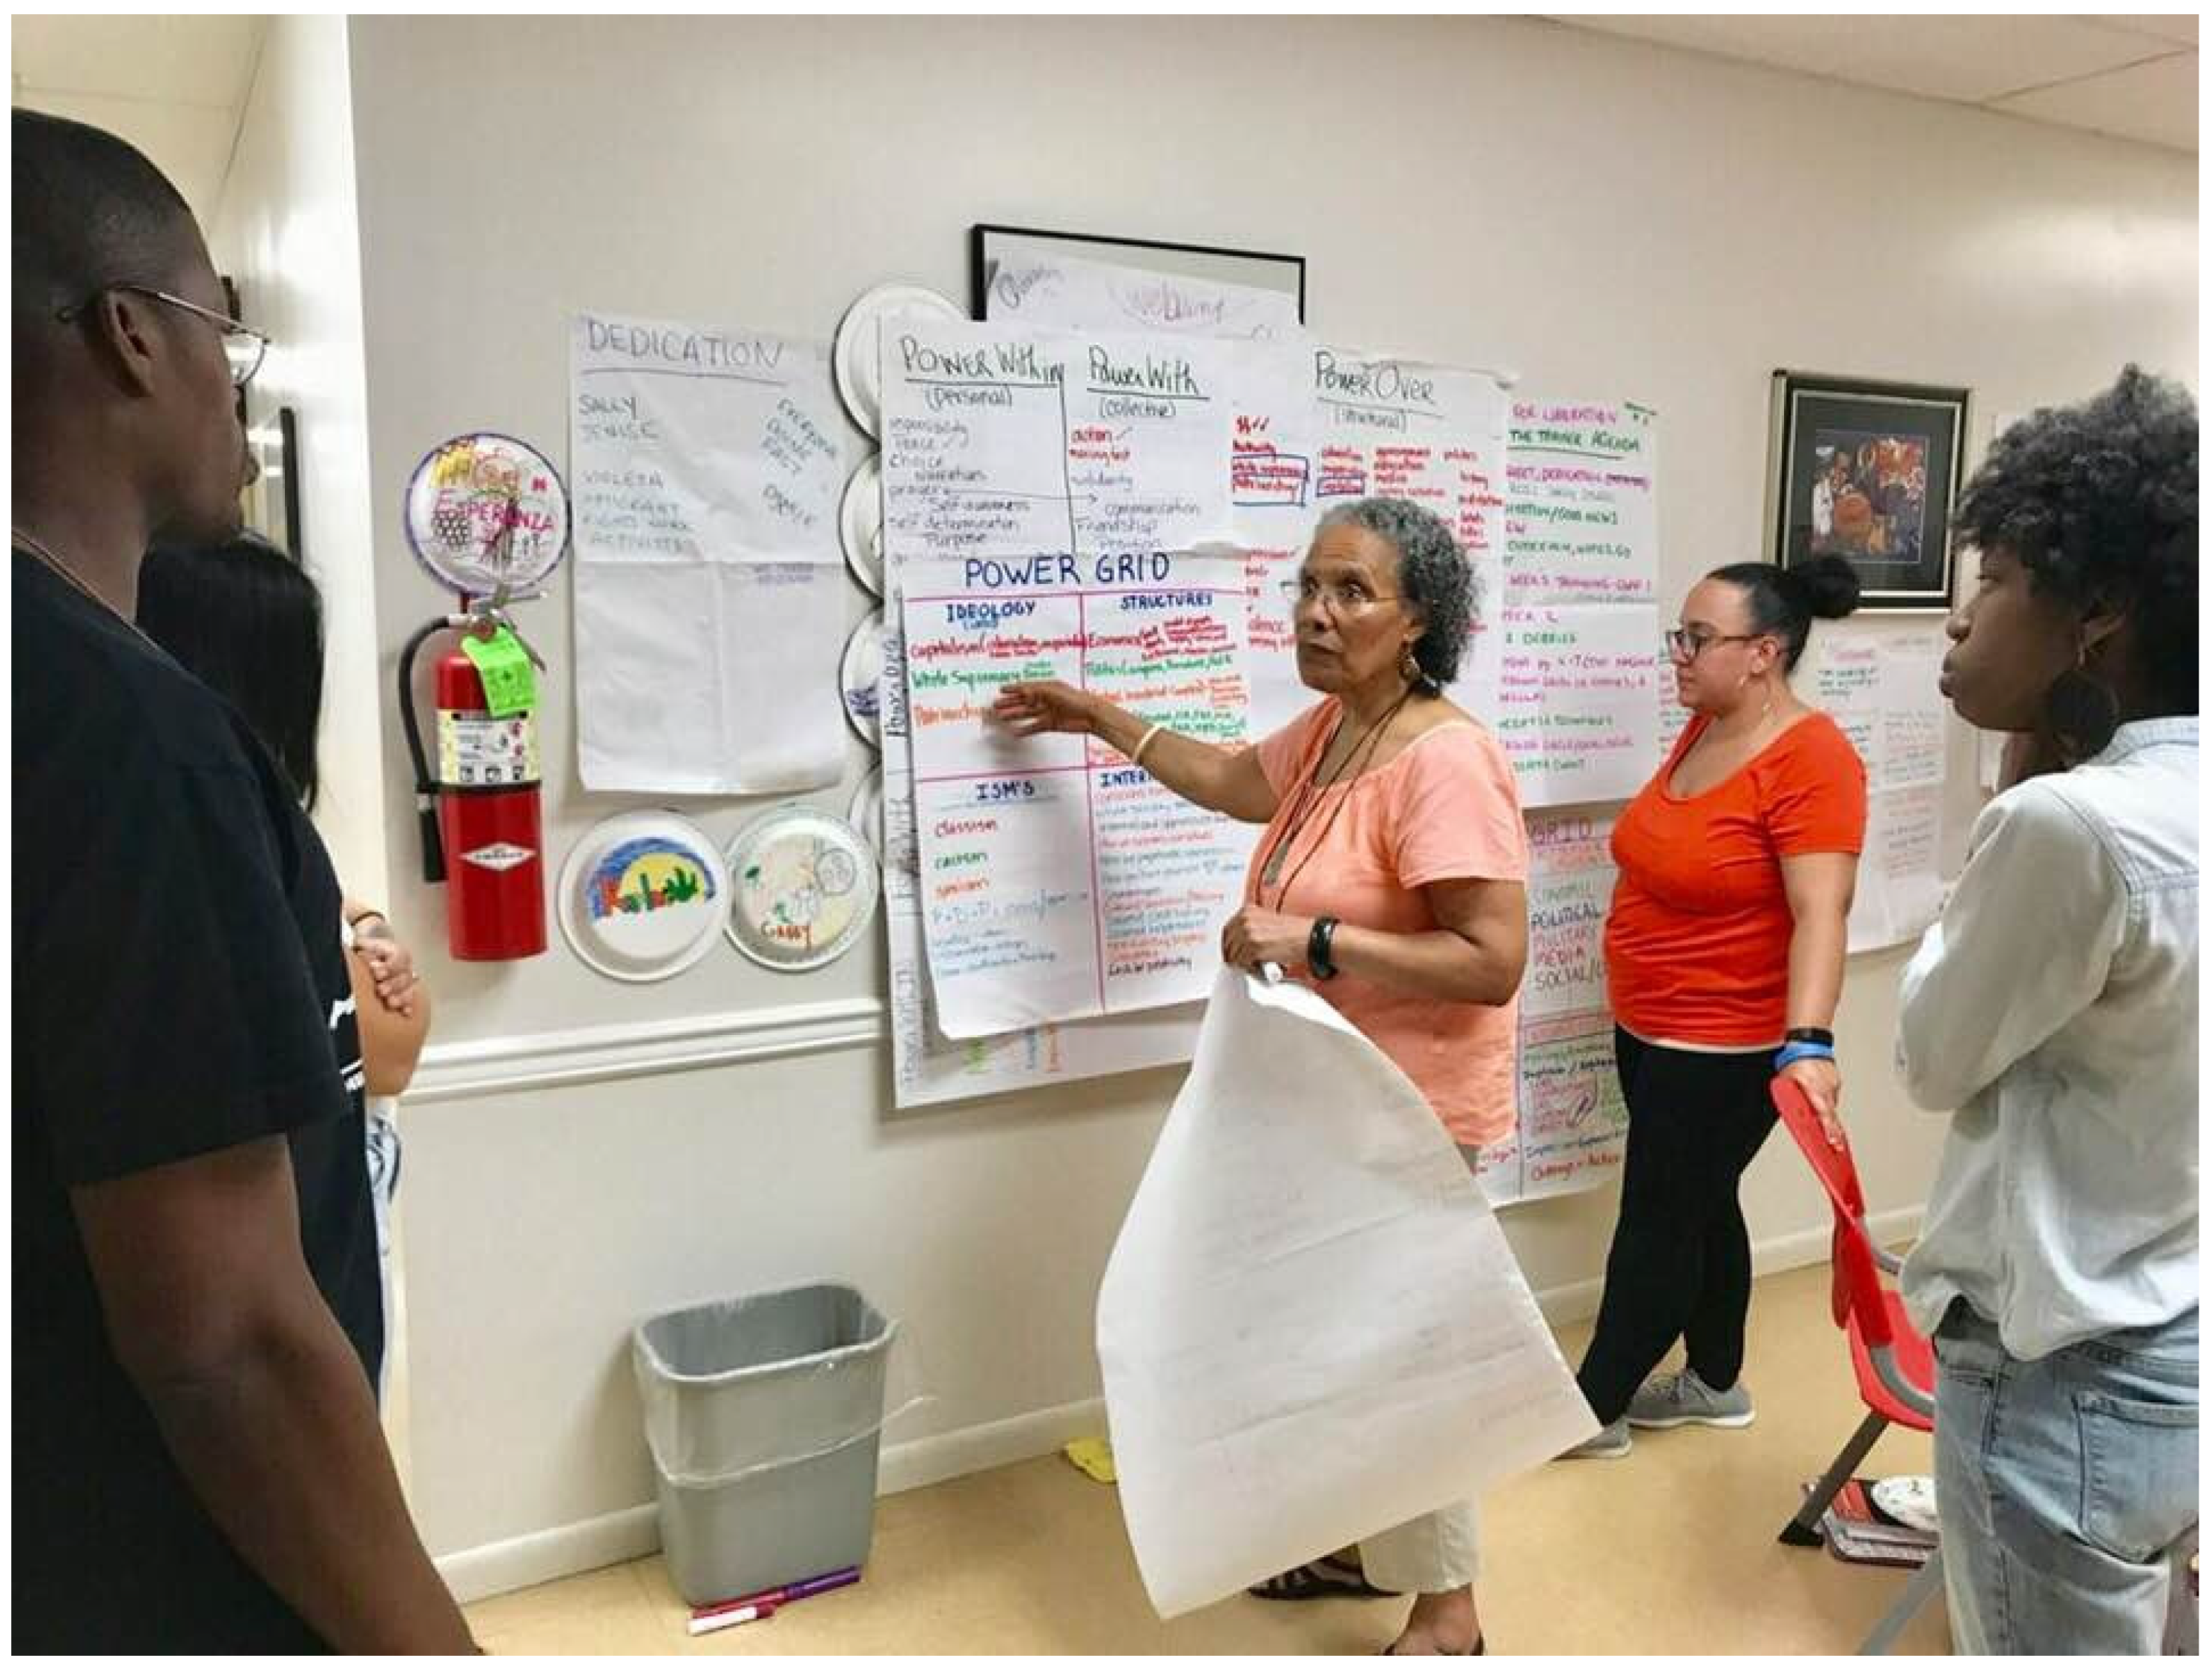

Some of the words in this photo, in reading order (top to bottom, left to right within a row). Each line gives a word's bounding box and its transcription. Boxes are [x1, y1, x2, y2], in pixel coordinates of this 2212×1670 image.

[587, 319, 783, 367] DEDICATION
[579, 394, 637, 421] SALLY
[965, 553, 1082, 588] POWER
[1096, 551, 1171, 583] GRID
[946, 600, 1036, 623] IDEOLOGY
[1120, 594, 1214, 611] STRUCTURES
[975, 779, 1036, 801] ISM'S
[1530, 902, 1602, 927] POLITICAL
[1535, 944, 1587, 966] MEDIA
